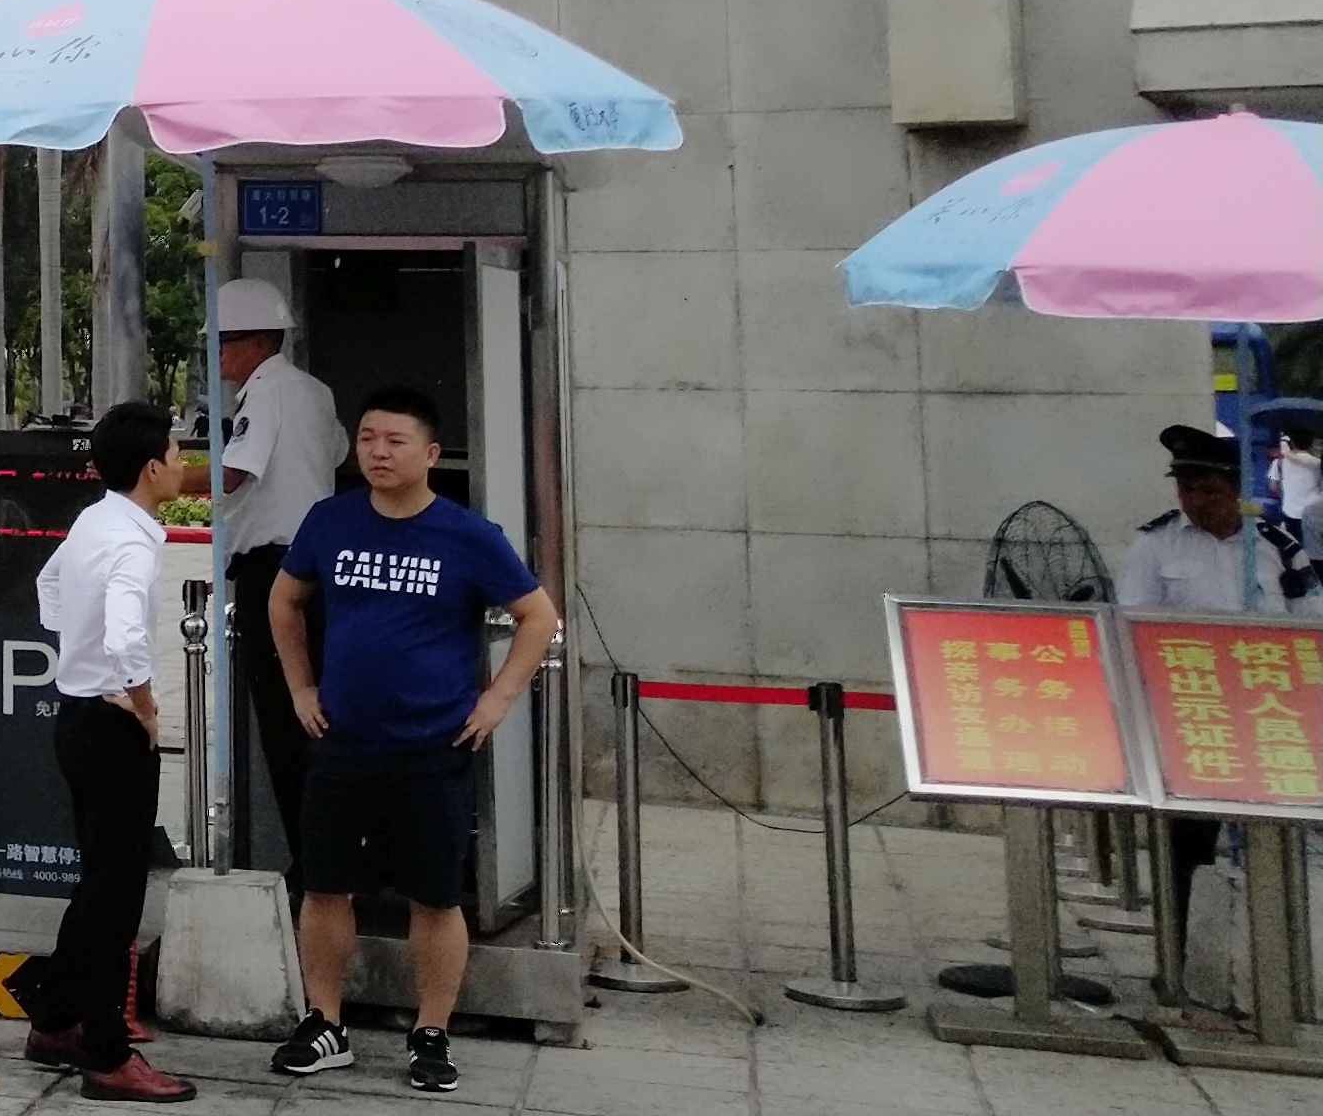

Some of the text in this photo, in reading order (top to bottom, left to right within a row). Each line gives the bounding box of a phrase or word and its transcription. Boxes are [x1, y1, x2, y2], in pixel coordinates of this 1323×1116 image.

[259, 205, 290, 225] 1-2
[334, 549, 442, 597] CALVIN
[2, 639, 59, 715] P
[1228, 639, 1320, 797] 校内人员通道
